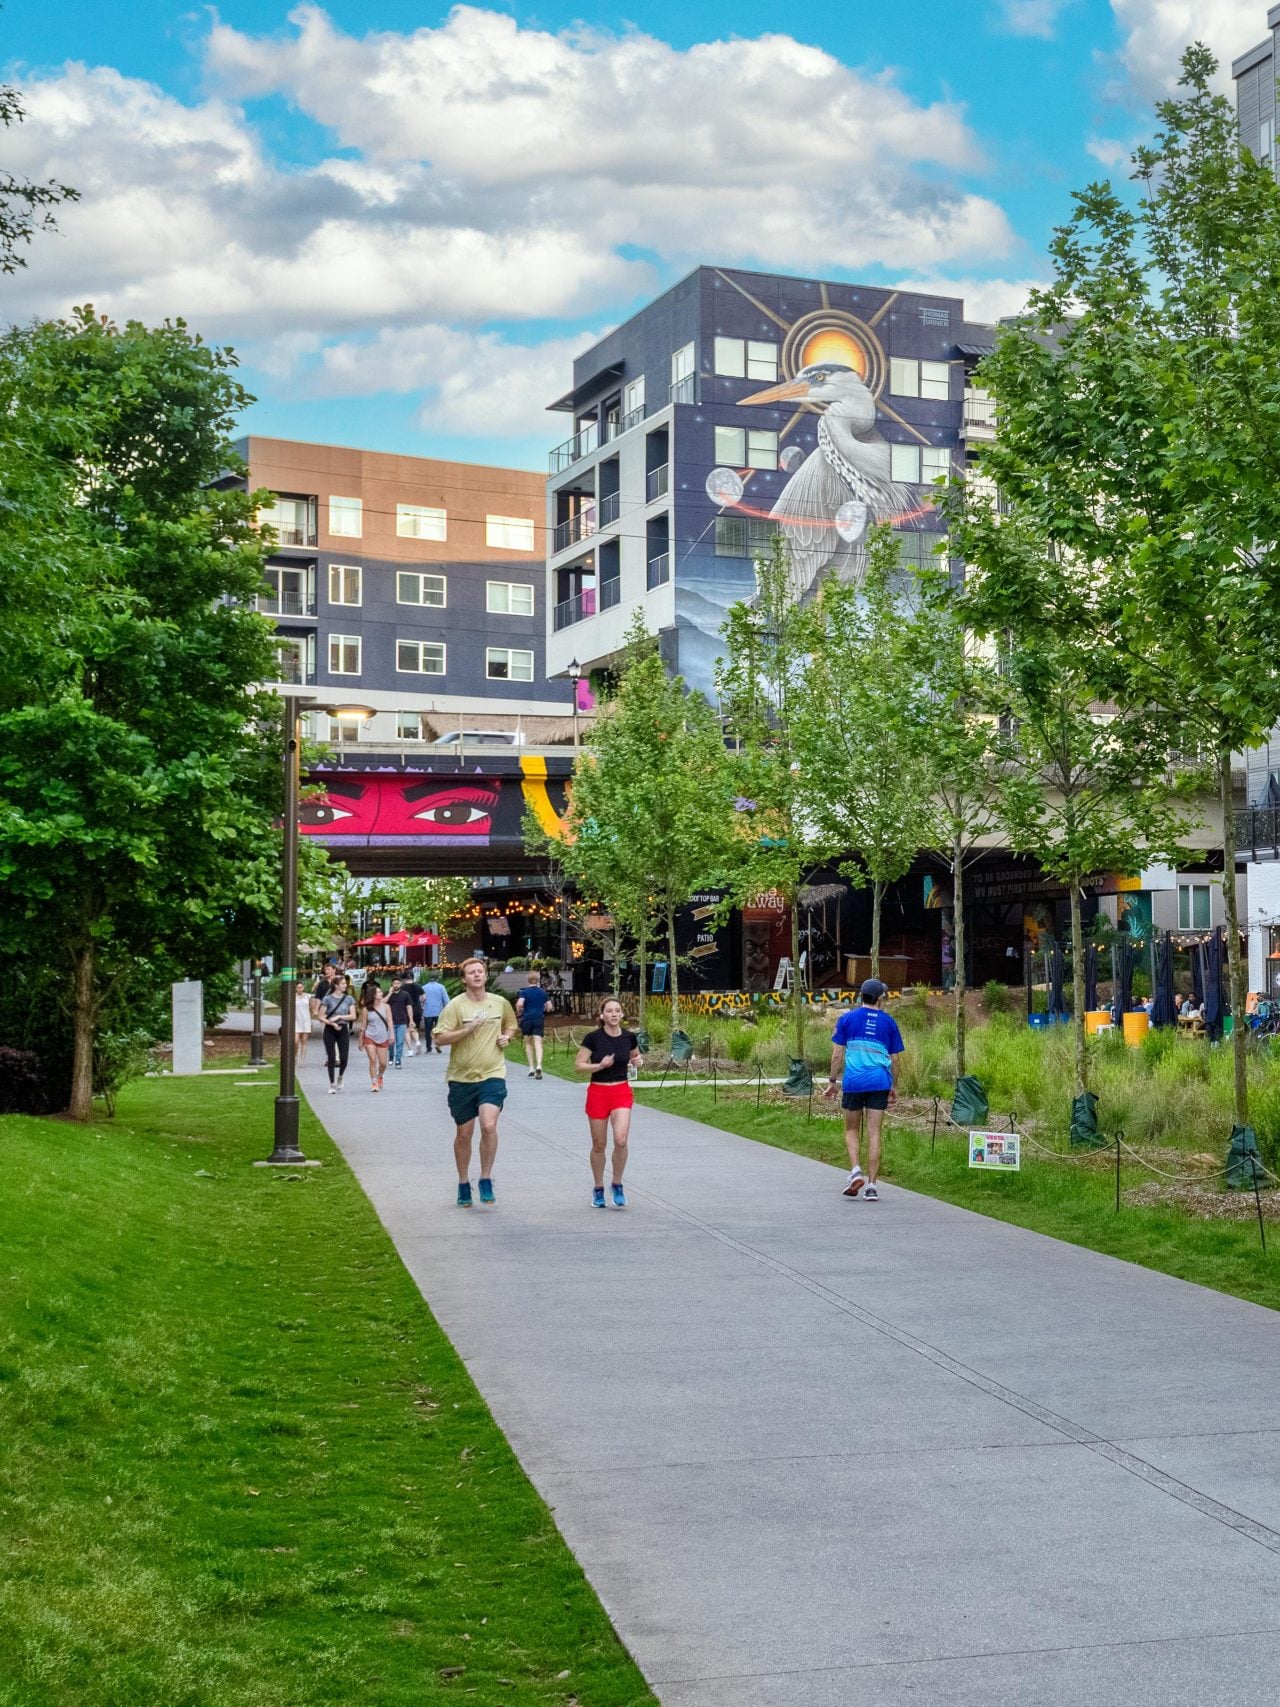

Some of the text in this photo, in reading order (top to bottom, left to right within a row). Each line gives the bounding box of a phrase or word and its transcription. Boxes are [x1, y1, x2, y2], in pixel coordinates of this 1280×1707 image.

[918, 307, 950, 319] THOMAS
[918, 315, 950, 328] TURNER
[697, 934, 714, 943] PATIO
